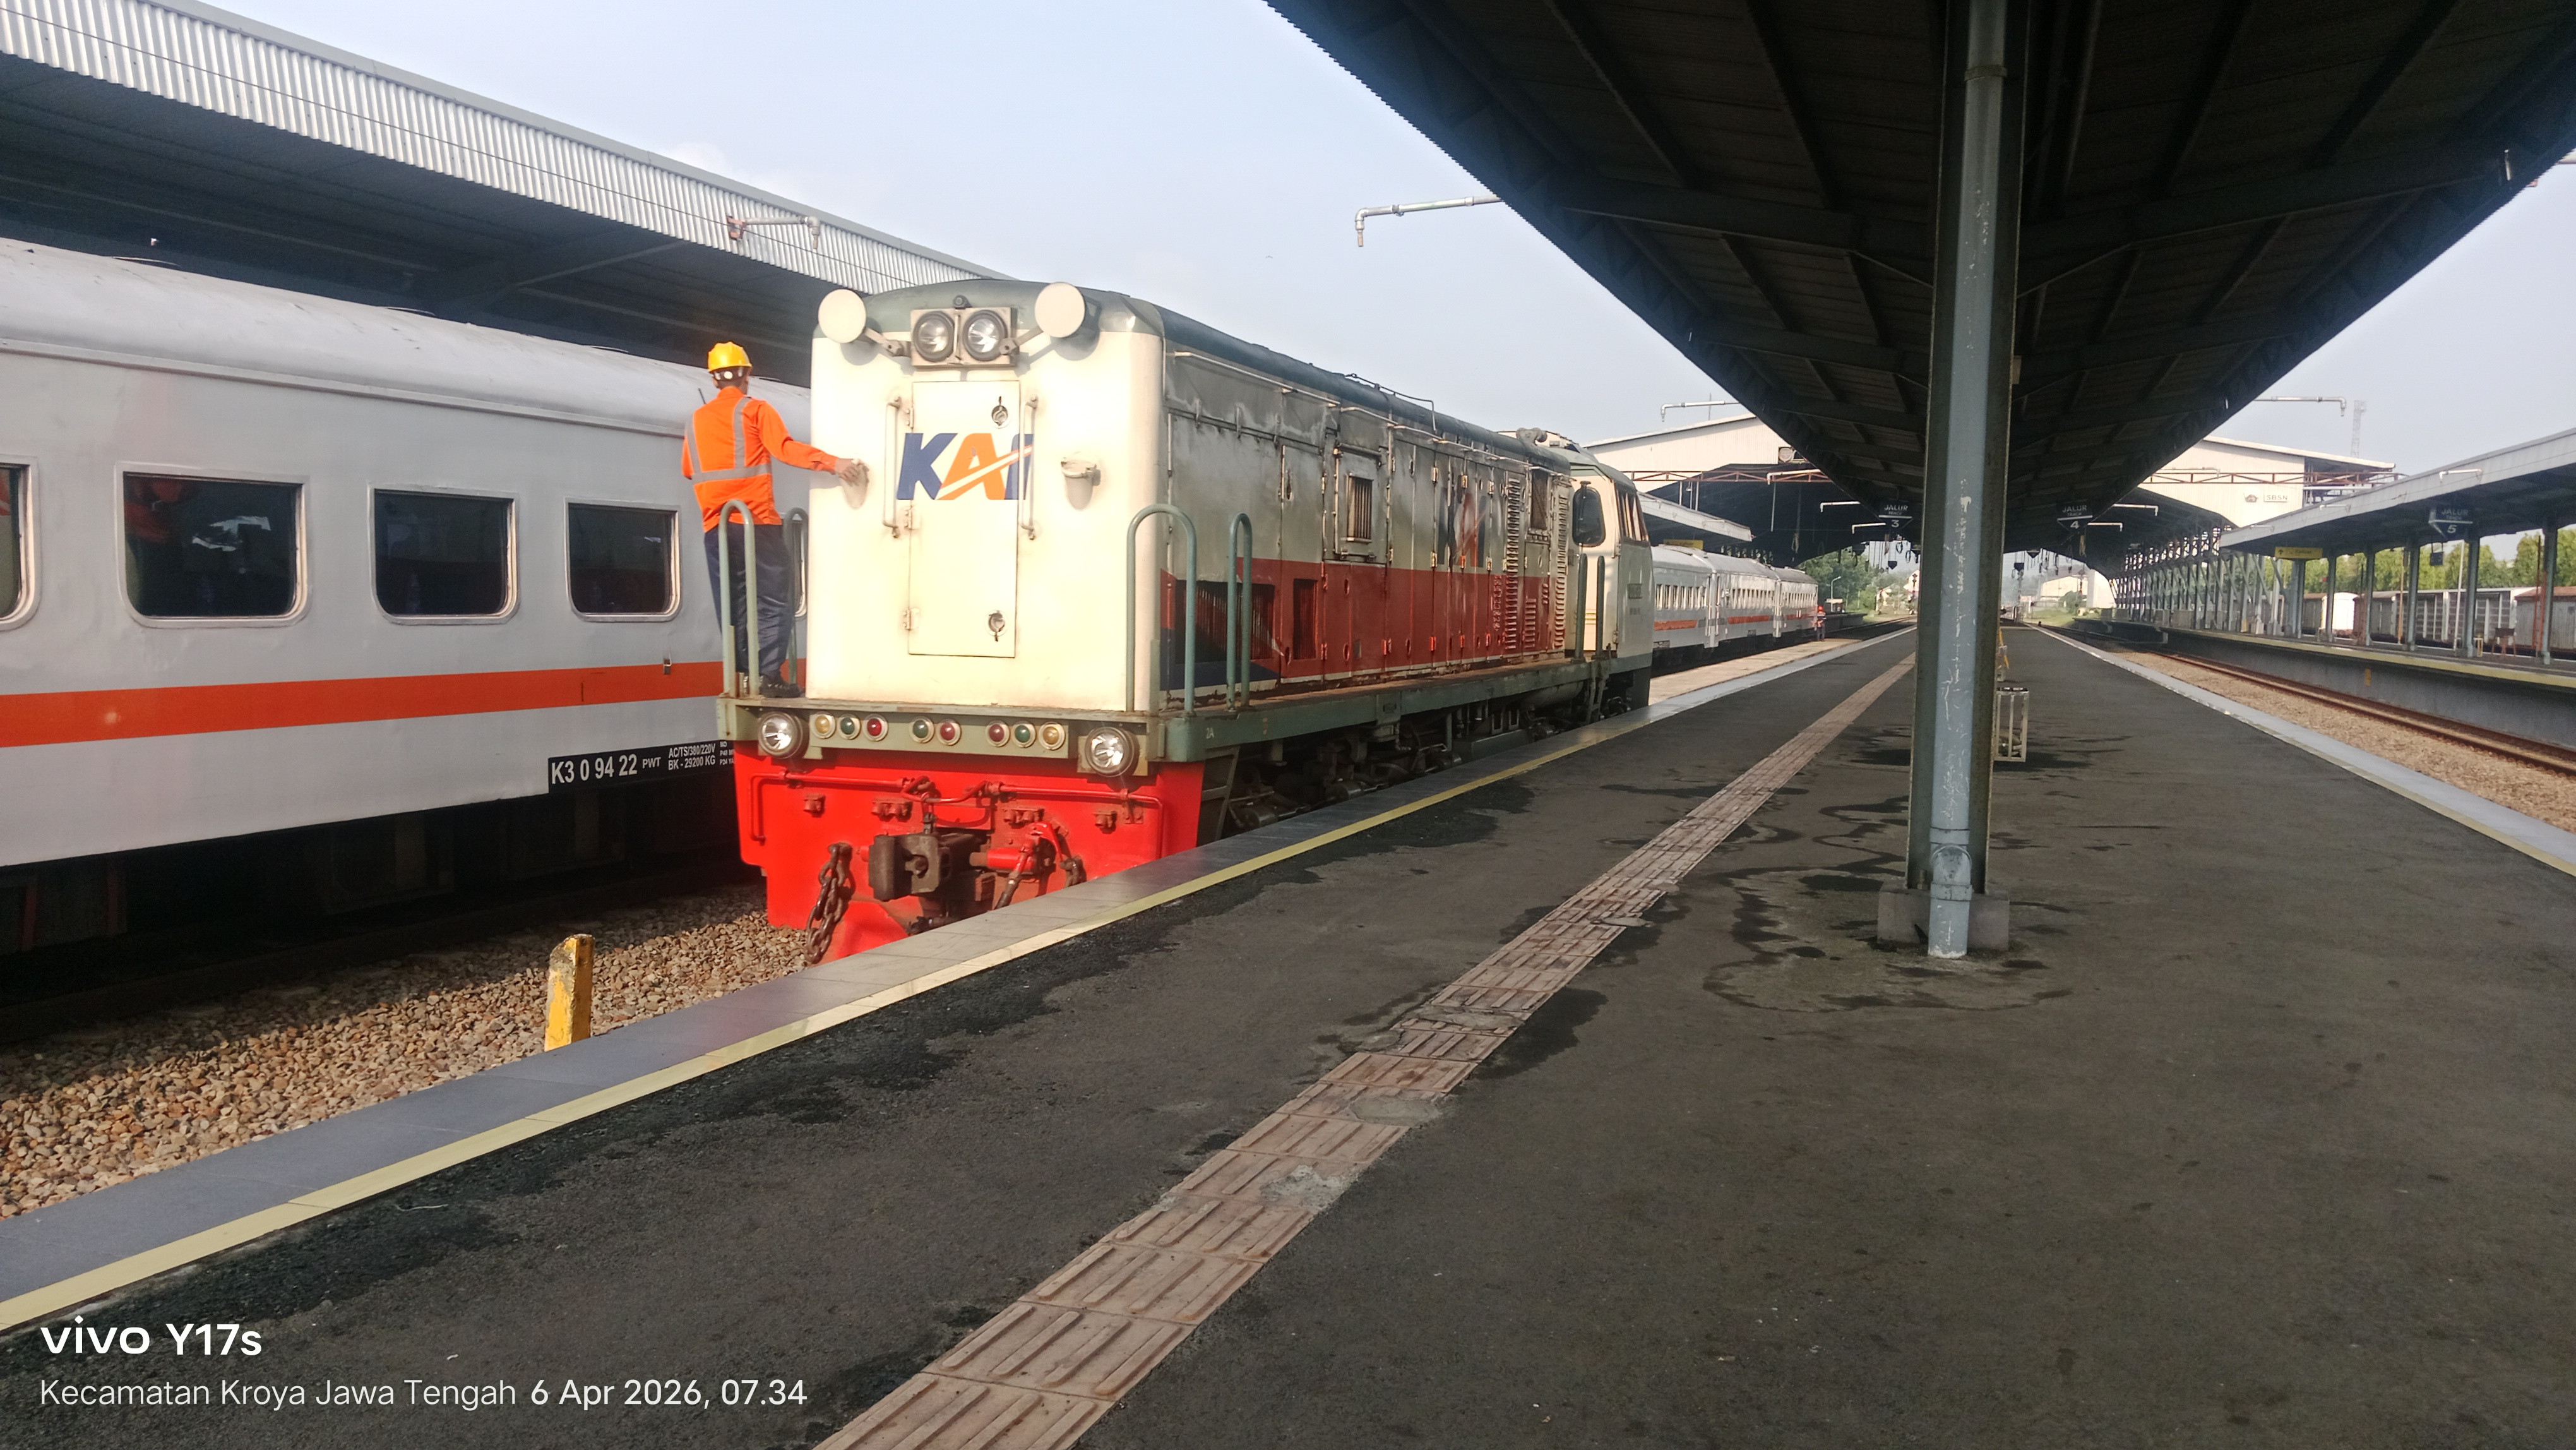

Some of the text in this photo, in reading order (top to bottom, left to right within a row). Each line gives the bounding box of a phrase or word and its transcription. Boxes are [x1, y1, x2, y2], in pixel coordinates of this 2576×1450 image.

[897, 433, 1034, 500] KAI
[2062, 505, 2087, 513] JALUR
[1891, 519, 1899, 527] 3
[2070, 520, 2079, 529] 4
[2447, 524, 2457, 533] 5
[668, 759, 679, 770] BK
[684, 756, 703, 769] 29200
[705, 755, 715, 765] KG
[551, 753, 662, 784] K3 0 94 22 PWT
